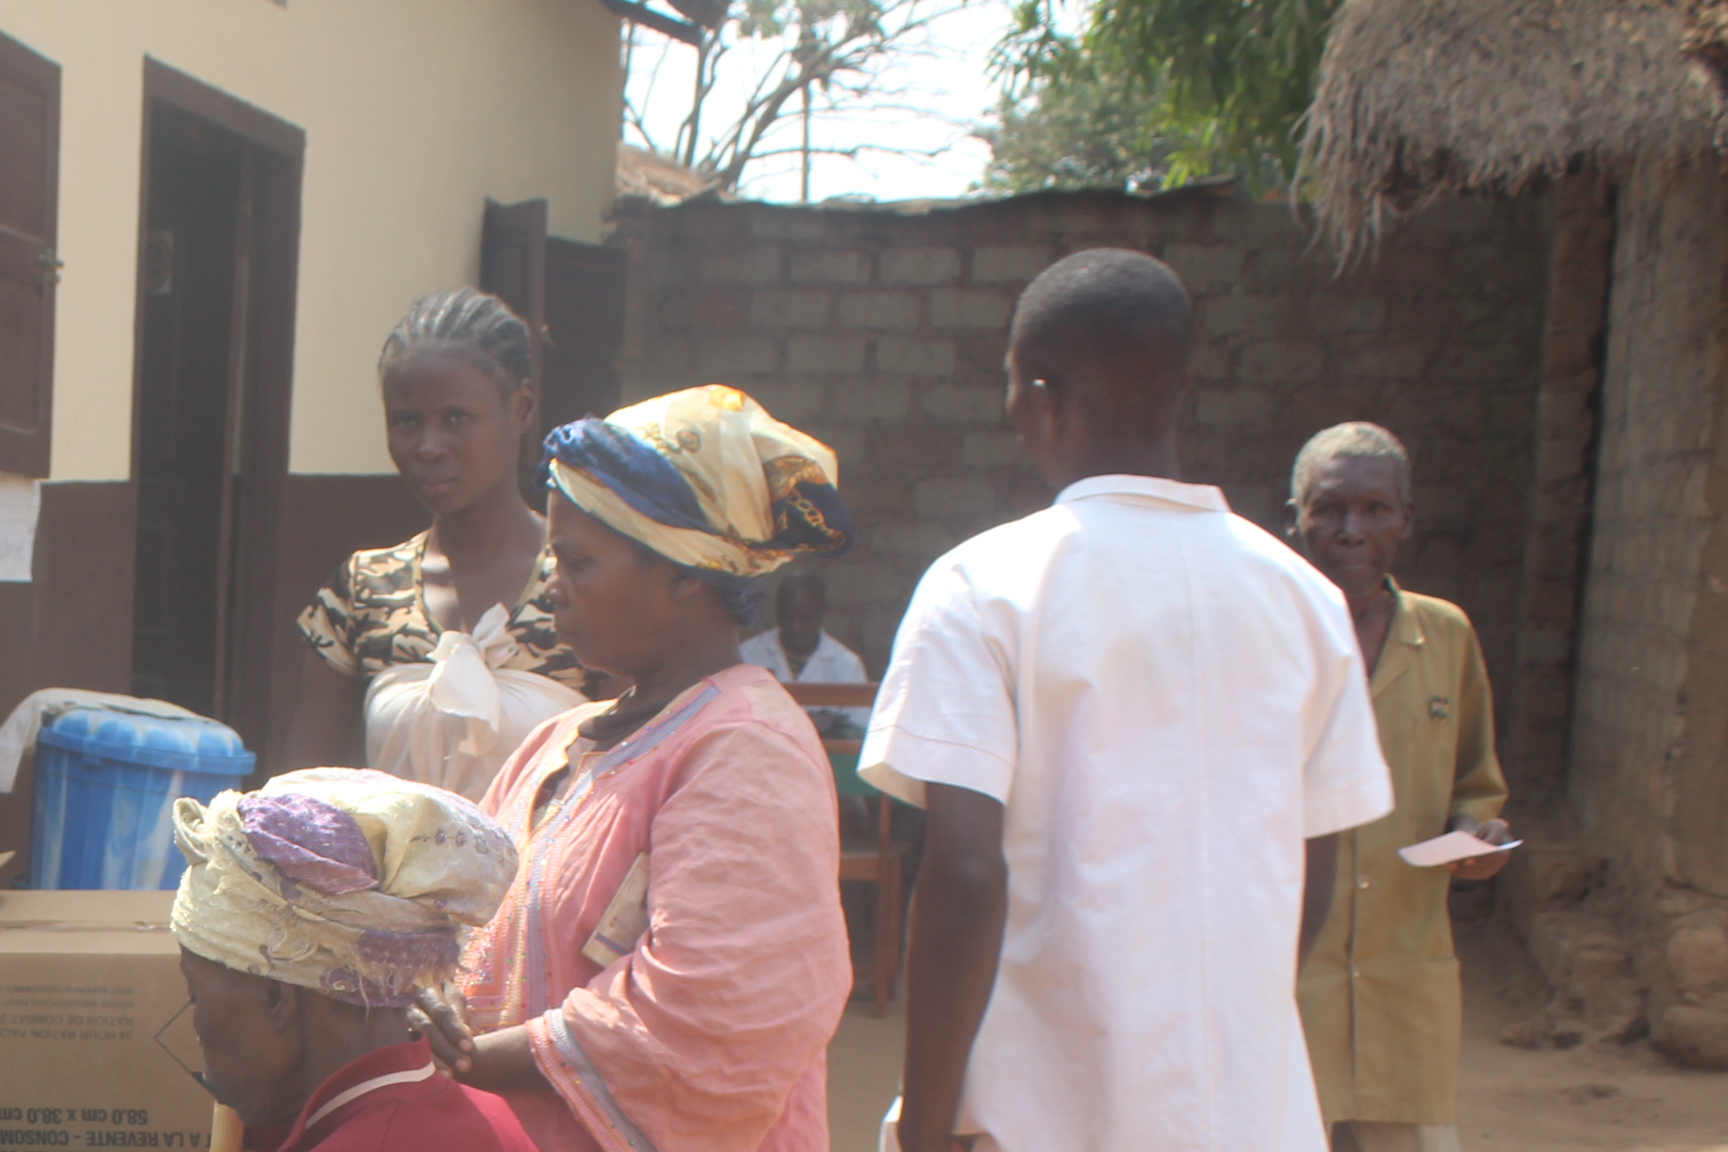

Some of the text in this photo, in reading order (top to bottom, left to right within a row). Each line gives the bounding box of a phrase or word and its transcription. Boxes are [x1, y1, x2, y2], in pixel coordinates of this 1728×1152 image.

[27, 1108, 62, 1124] 38.0
[67, 1109, 77, 1121] x
[82, 1109, 107, 1121] cm
[112, 1109, 148, 1125] 58.0
[86, 1131, 158, 1147] REVENTE
[163, 1131, 184, 1147] LA
[189, 1132, 201, 1147] A
